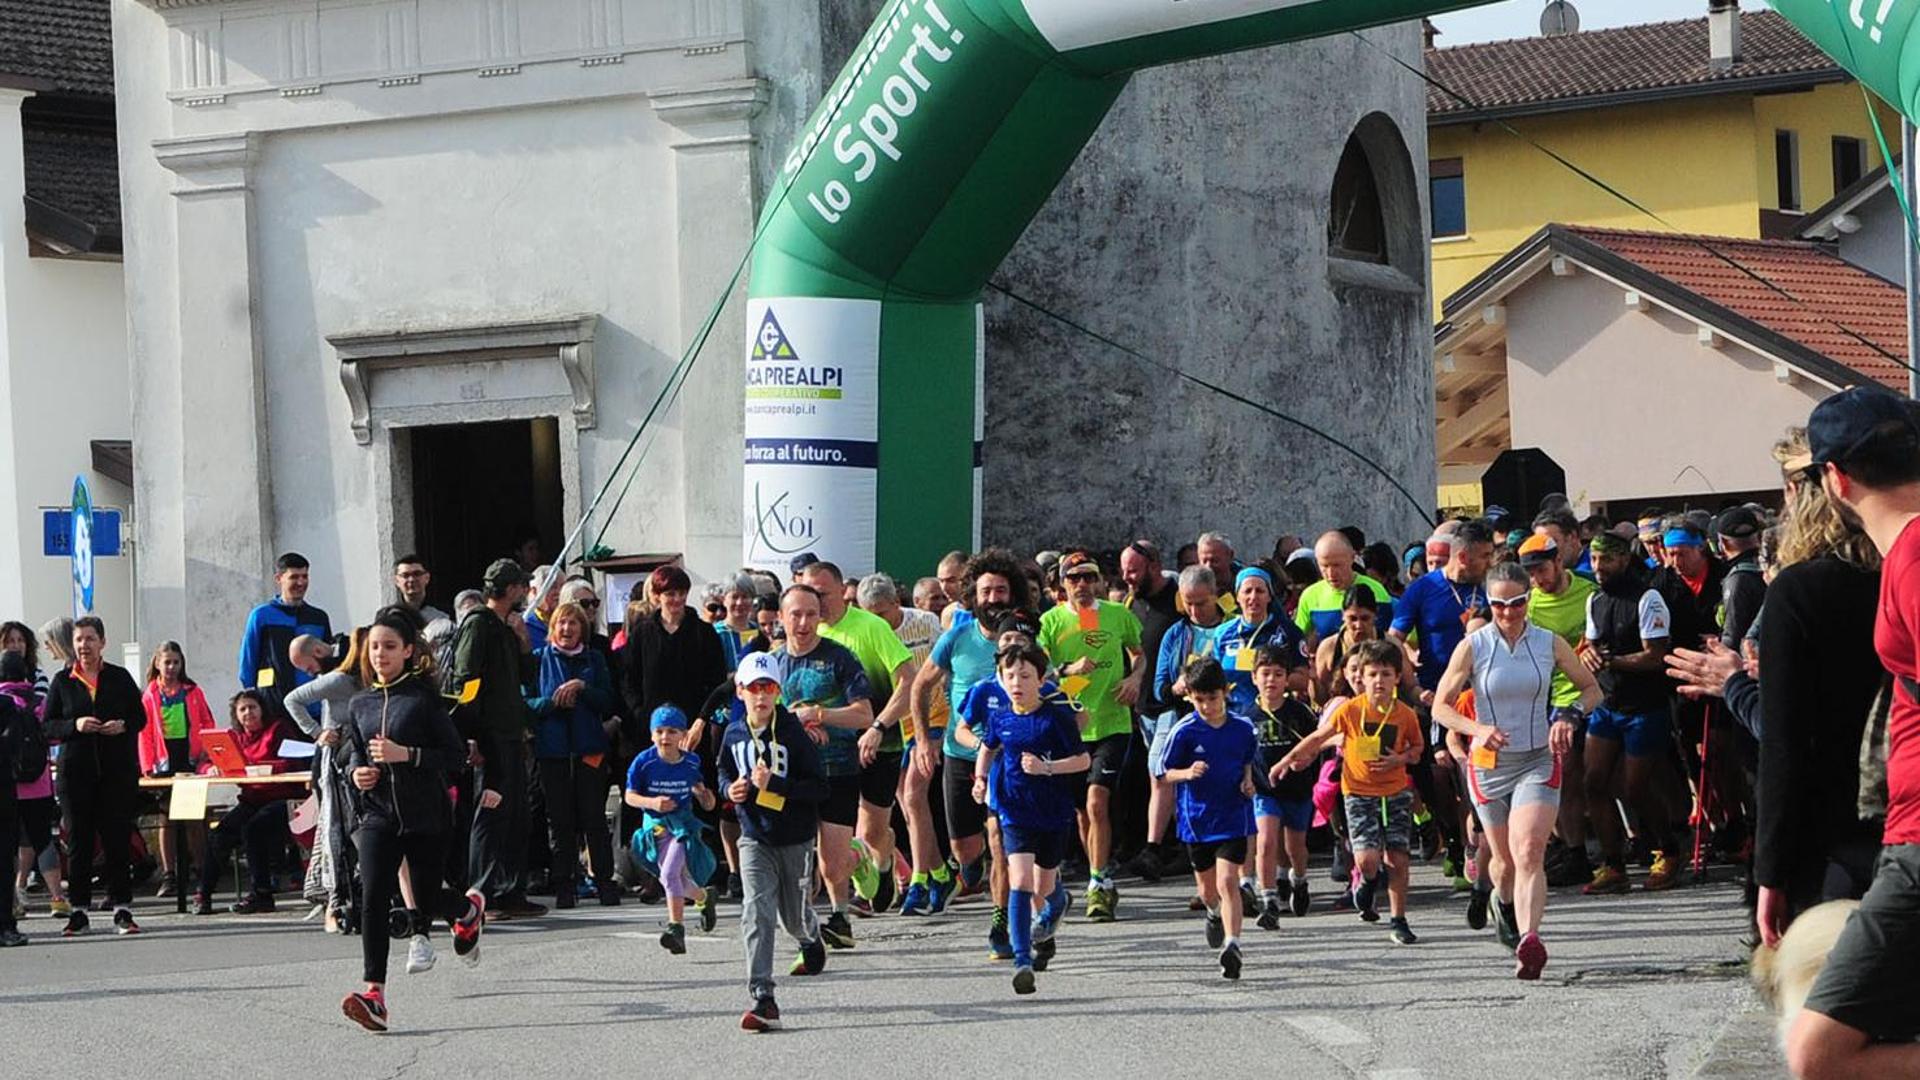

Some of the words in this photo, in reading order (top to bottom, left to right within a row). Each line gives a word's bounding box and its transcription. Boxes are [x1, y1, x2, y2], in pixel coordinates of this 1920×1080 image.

[806, 178, 852, 226] lo
[833, 0, 966, 184] Sport!
[764, 367, 842, 387] PREALPI
[777, 444, 790, 461] al
[793, 444, 848, 464] futuro.
